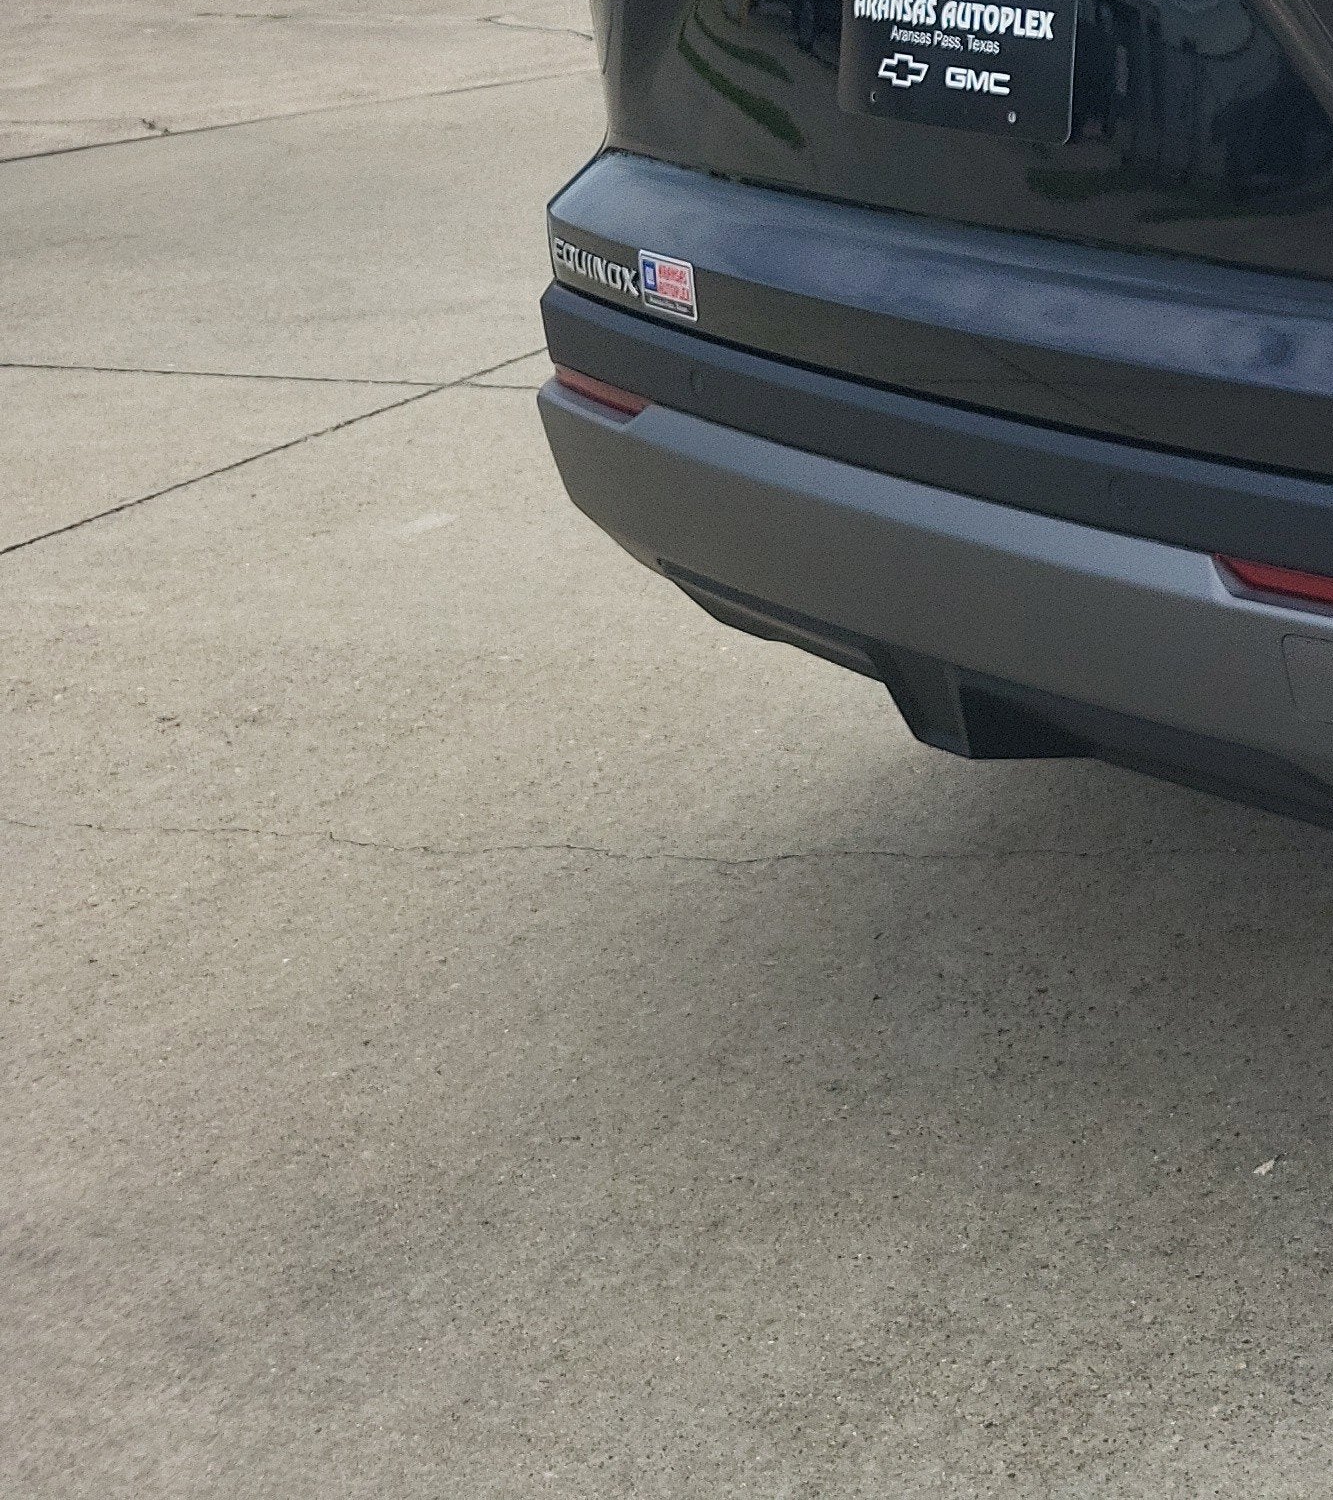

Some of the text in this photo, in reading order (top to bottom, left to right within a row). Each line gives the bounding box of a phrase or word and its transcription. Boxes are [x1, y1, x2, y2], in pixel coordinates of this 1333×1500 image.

[941, 0, 1055, 40] AUTOPLEX
[890, 25, 1000, 55] Aransas Pass, Texas
[945, 66, 1011, 95] GMC
[554, 237, 640, 298] EQUINOX
